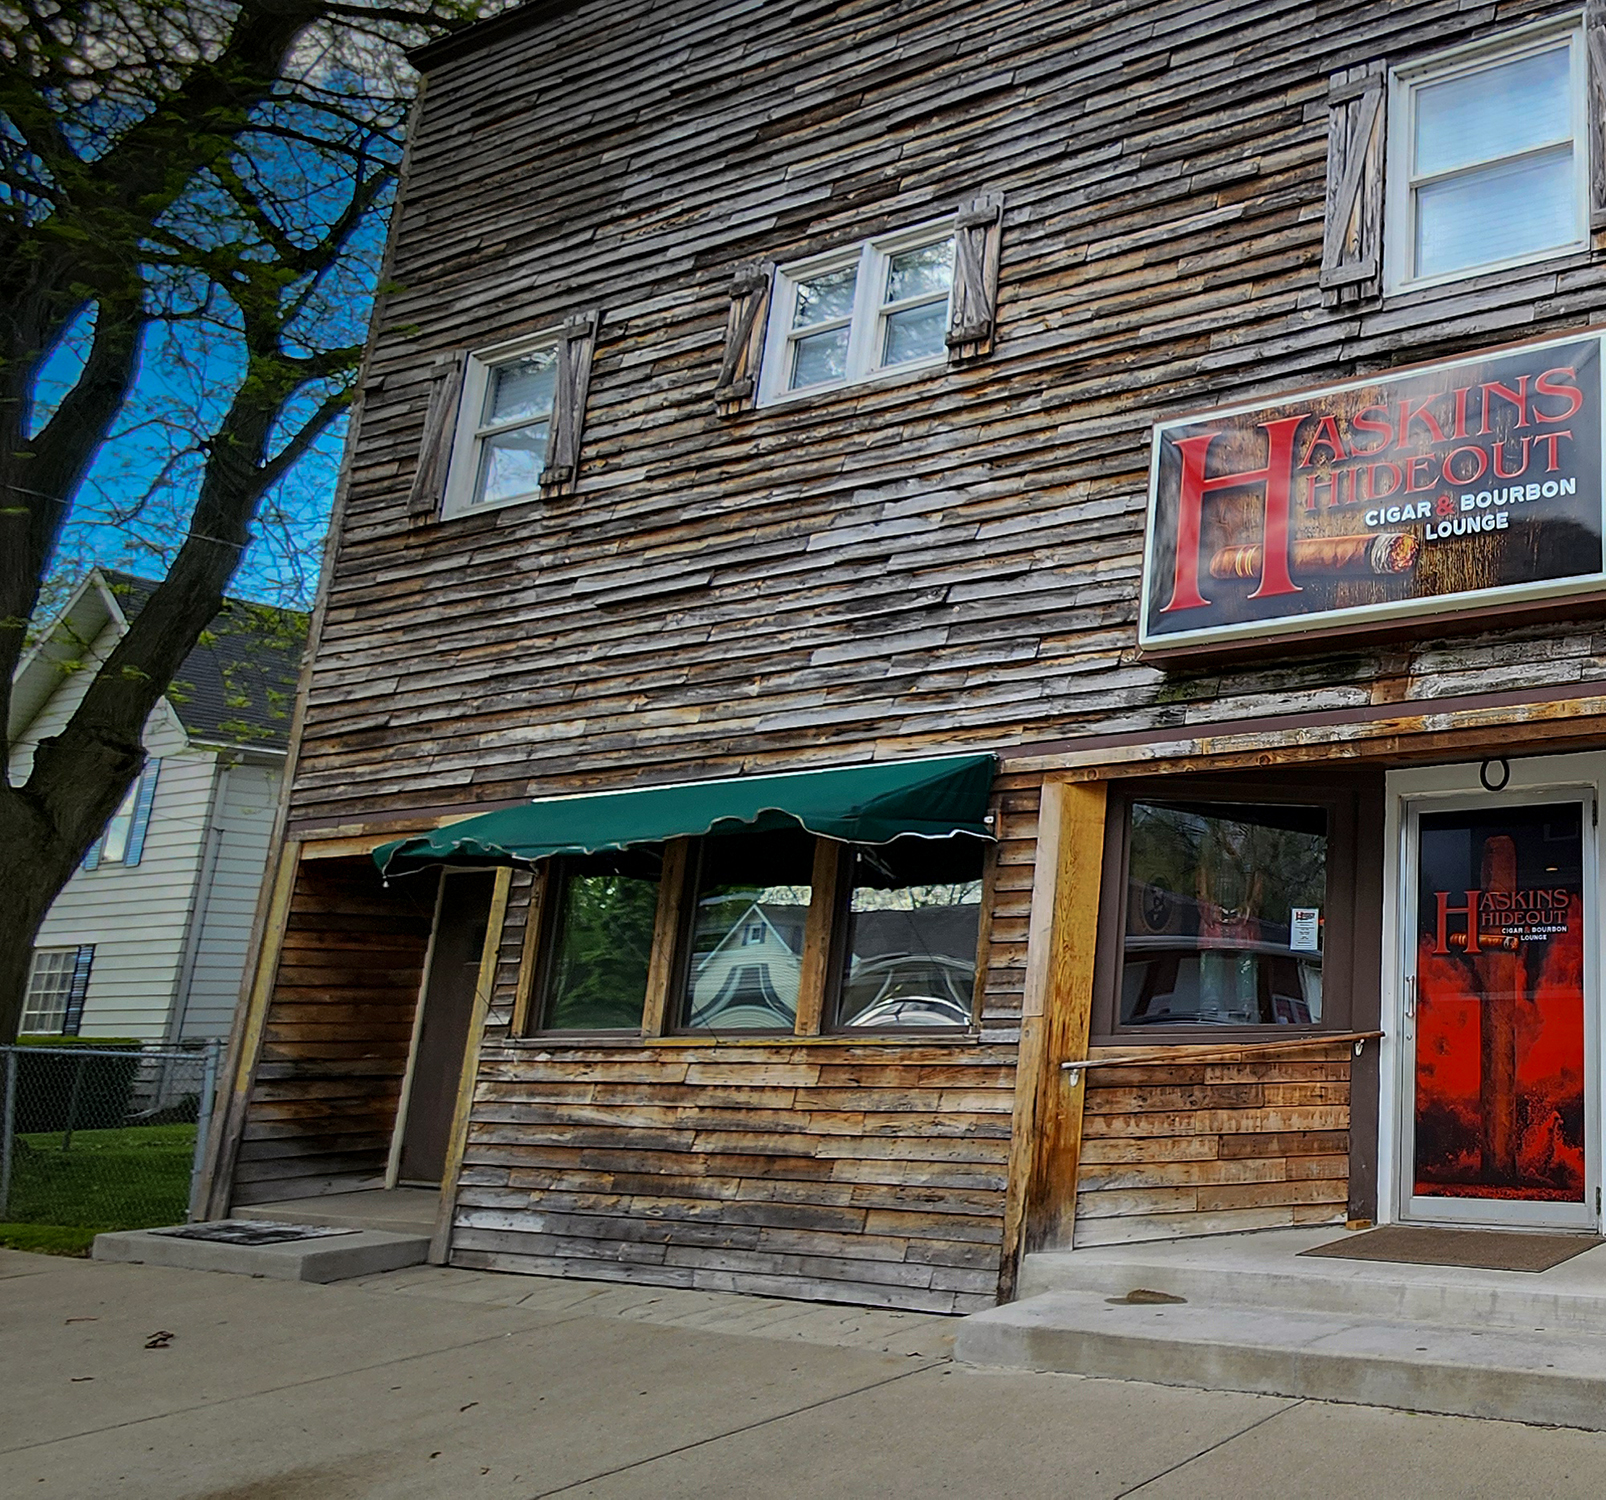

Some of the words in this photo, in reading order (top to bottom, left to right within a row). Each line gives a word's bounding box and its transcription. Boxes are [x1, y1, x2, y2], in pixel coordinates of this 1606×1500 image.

[1160, 366, 1584, 613] HASKINS
[1304, 430, 1574, 513] HIDEOUT
[1364, 500, 1432, 528] CIGAR
[1436, 494, 1457, 516] &
[1460, 477, 1577, 511] BOURBON
[1425, 511, 1509, 541] LOUNGE
[1432, 889, 1570, 954] HASKINS
[1481, 910, 1566, 926] HIDEOUT
[1531, 925, 1568, 933] BOURBON
